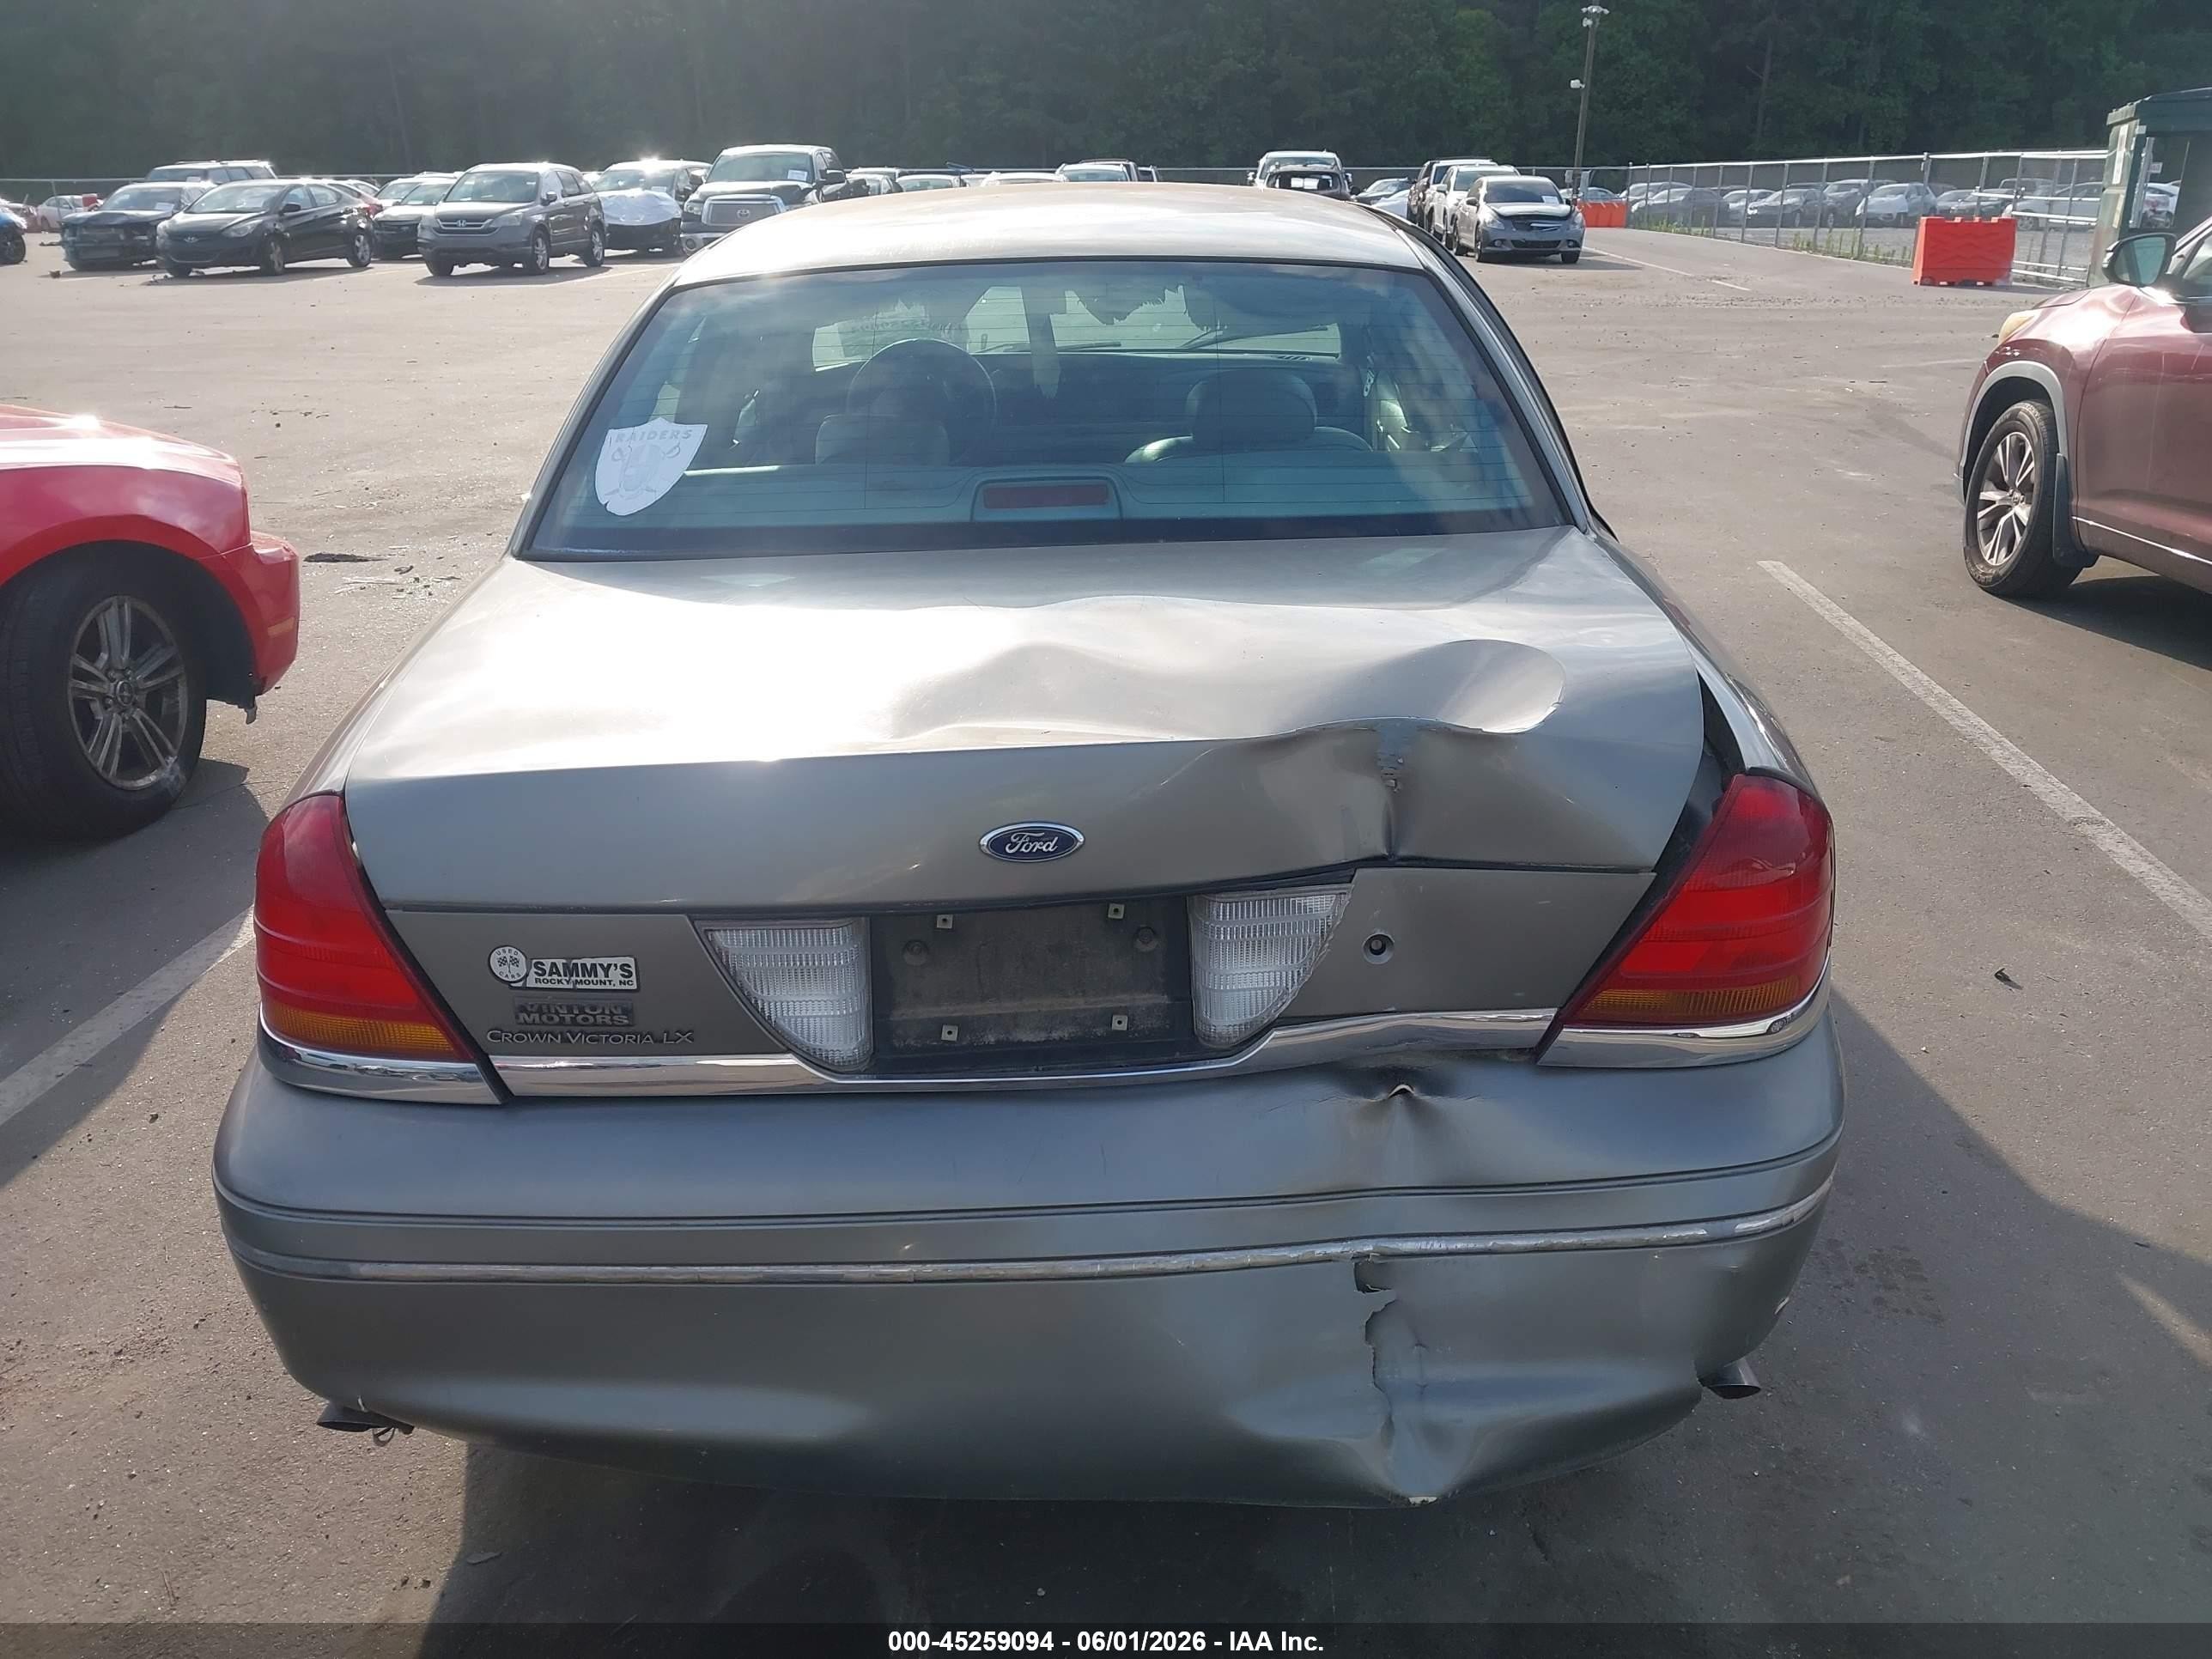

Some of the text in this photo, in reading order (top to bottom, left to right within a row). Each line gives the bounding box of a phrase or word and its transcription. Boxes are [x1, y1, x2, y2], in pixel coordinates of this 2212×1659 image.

[615, 429, 692, 443] RAIDERS
[1005, 832, 1059, 854] Ford
[499, 970, 522, 980] CARS
[533, 961, 634, 978] SAMMY'S
[574, 979, 616, 988] MOUNT,
[517, 1012, 629, 1025] MOTORS
[486, 1030, 694, 1045] CROWN VICTORIA LX
